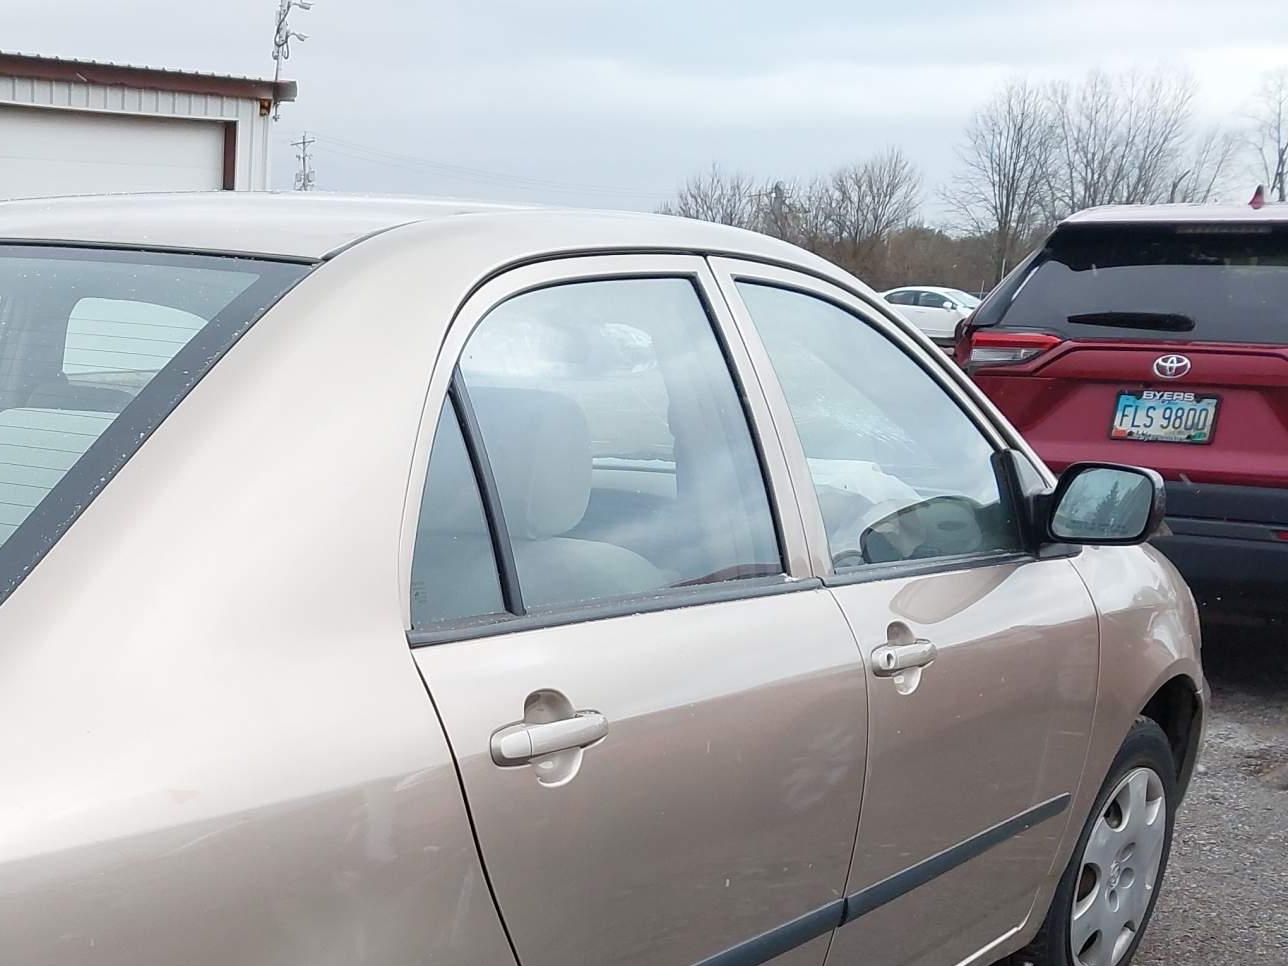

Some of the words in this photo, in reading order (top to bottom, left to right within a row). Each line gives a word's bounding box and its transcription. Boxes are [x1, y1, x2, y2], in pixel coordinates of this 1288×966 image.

[1142, 390, 1196, 402] BYERS
[1118, 404, 1157, 429] FLS
[1159, 406, 1210, 432] 9800
